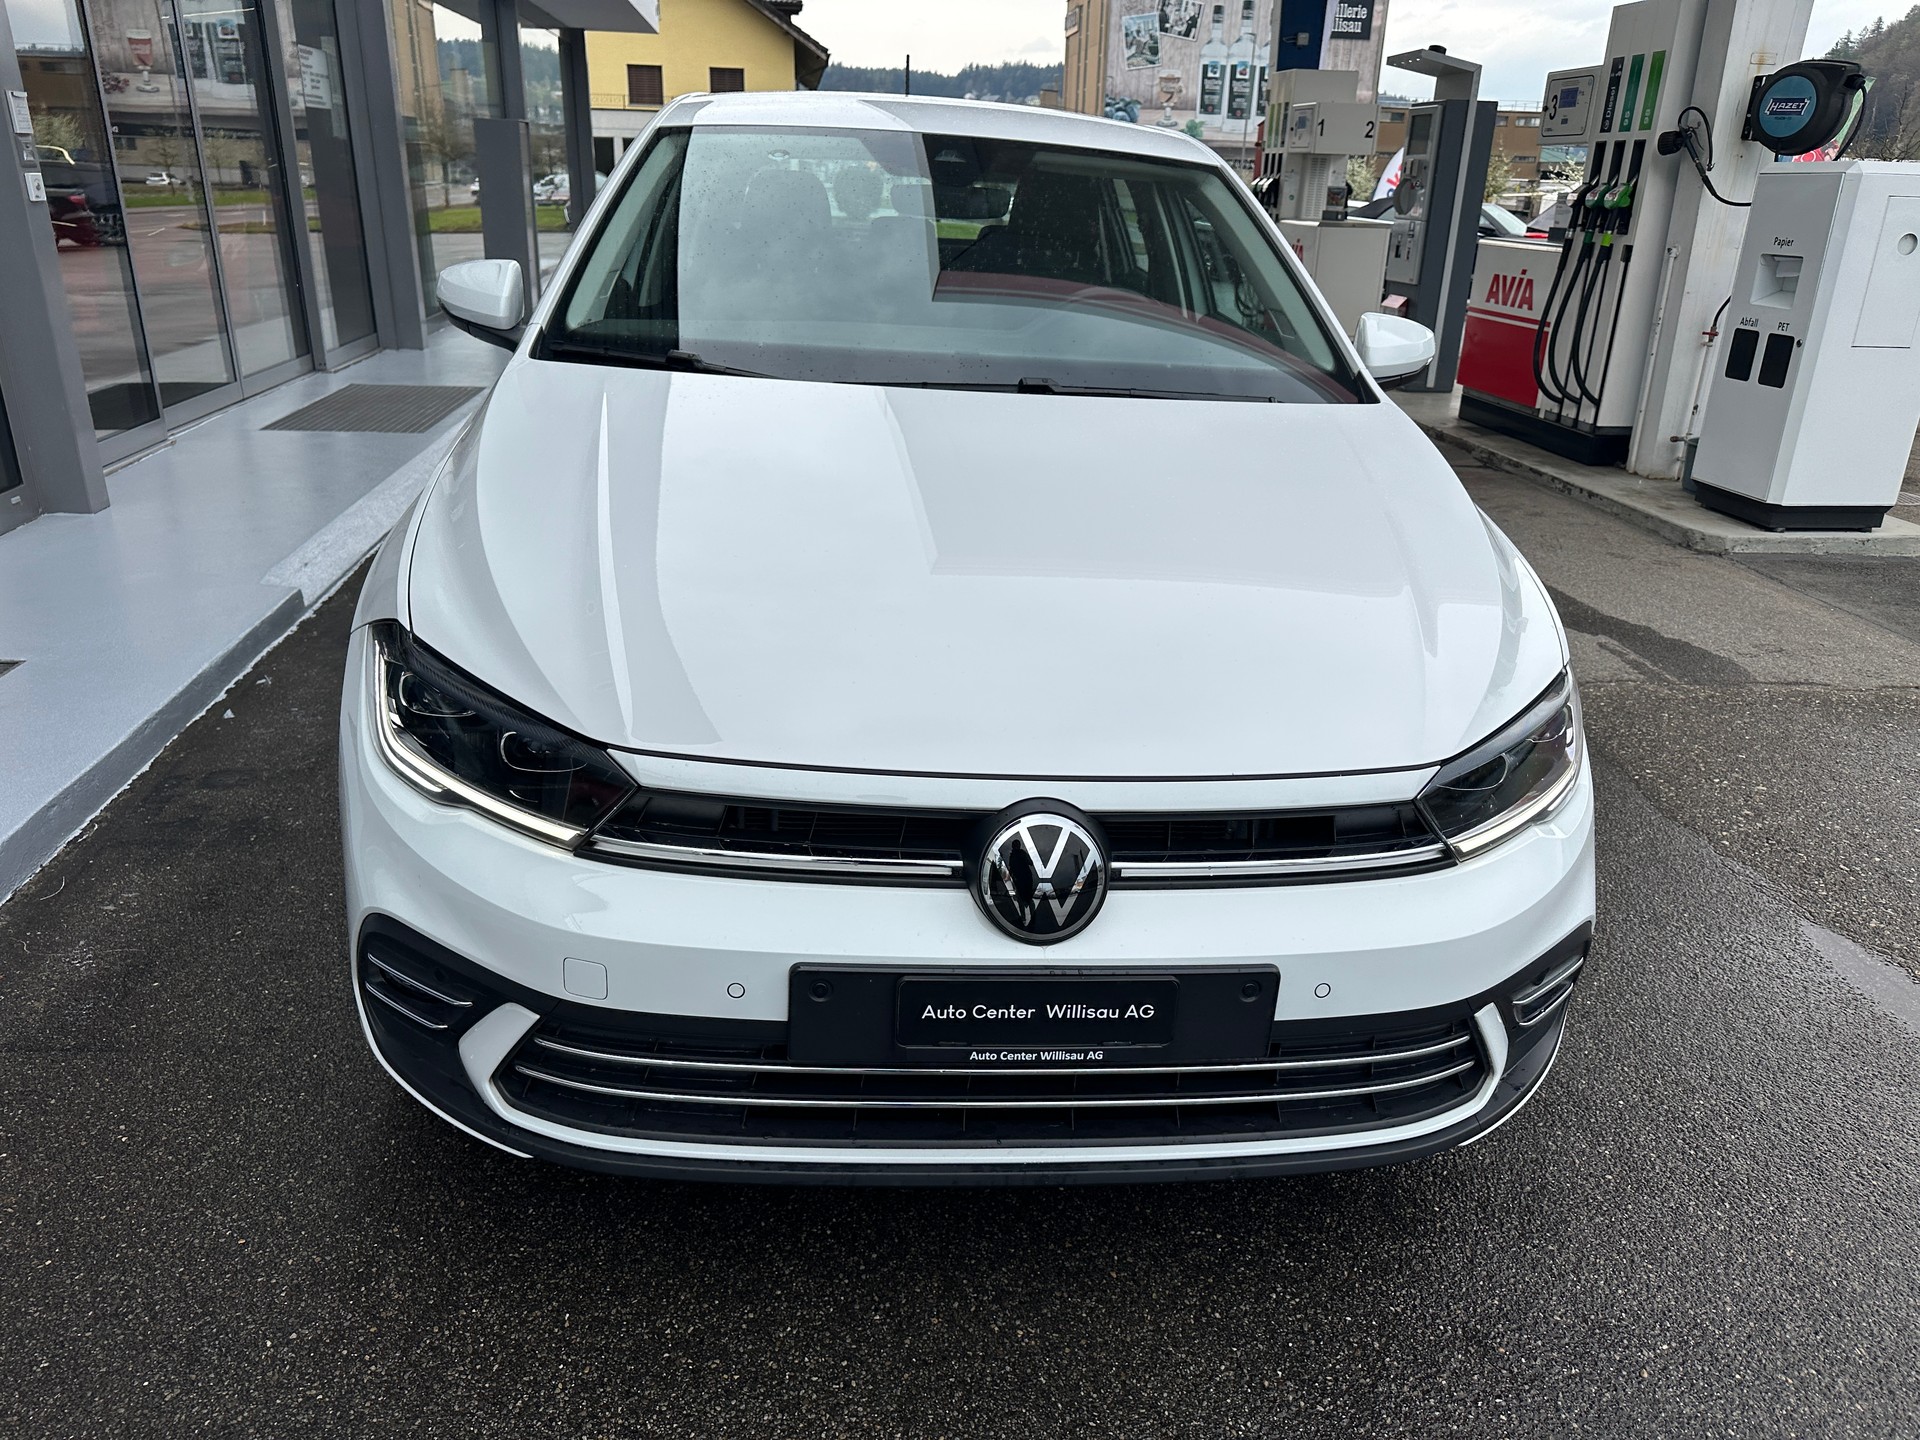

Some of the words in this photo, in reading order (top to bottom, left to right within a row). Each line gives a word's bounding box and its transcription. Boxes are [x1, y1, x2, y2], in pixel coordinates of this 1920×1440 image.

[1549, 94, 1558, 120] 3
[1769, 102, 1805, 111] HAZET
[1317, 118, 1325, 137] 1
[1364, 120, 1375, 139] 2
[1773, 236, 1795, 249] Papier
[1739, 317, 1760, 328] Abfall
[1777, 321, 1791, 332] PET
[921, 1004, 967, 1020] Auto
[972, 1004, 1036, 1020] Center
[1046, 1003, 1120, 1020] Willisau
[1124, 1003, 1155, 1019] AG
[969, 1051, 998, 1061] Auto
[1000, 1051, 1038, 1061] Center
[1039, 1050, 1085, 1061] Willisau
[1086, 1050, 1104, 1061] AG
